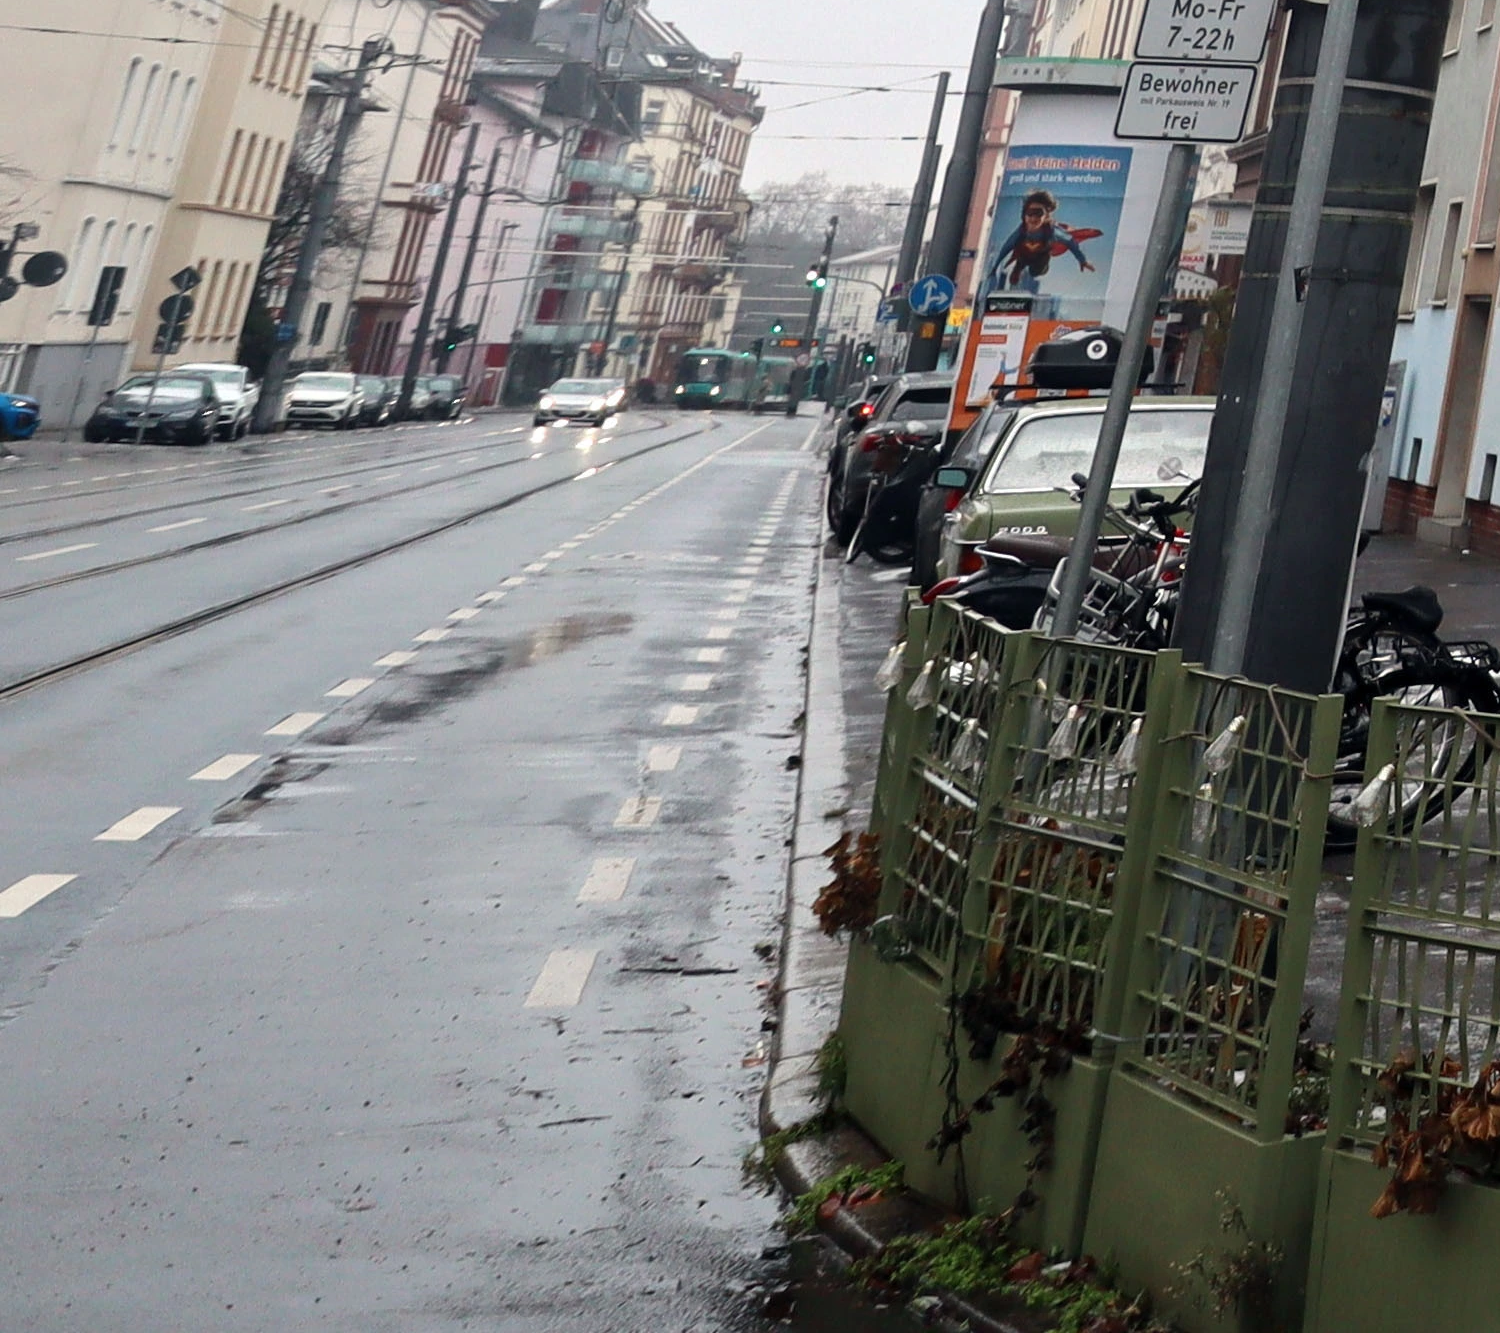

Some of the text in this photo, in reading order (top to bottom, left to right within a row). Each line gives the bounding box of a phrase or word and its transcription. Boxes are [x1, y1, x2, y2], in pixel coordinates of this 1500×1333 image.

[1139, 73, 1239, 94] Bewohner
[1163, 110, 1198, 131] frei
[1066, 174, 1102, 183] werden
